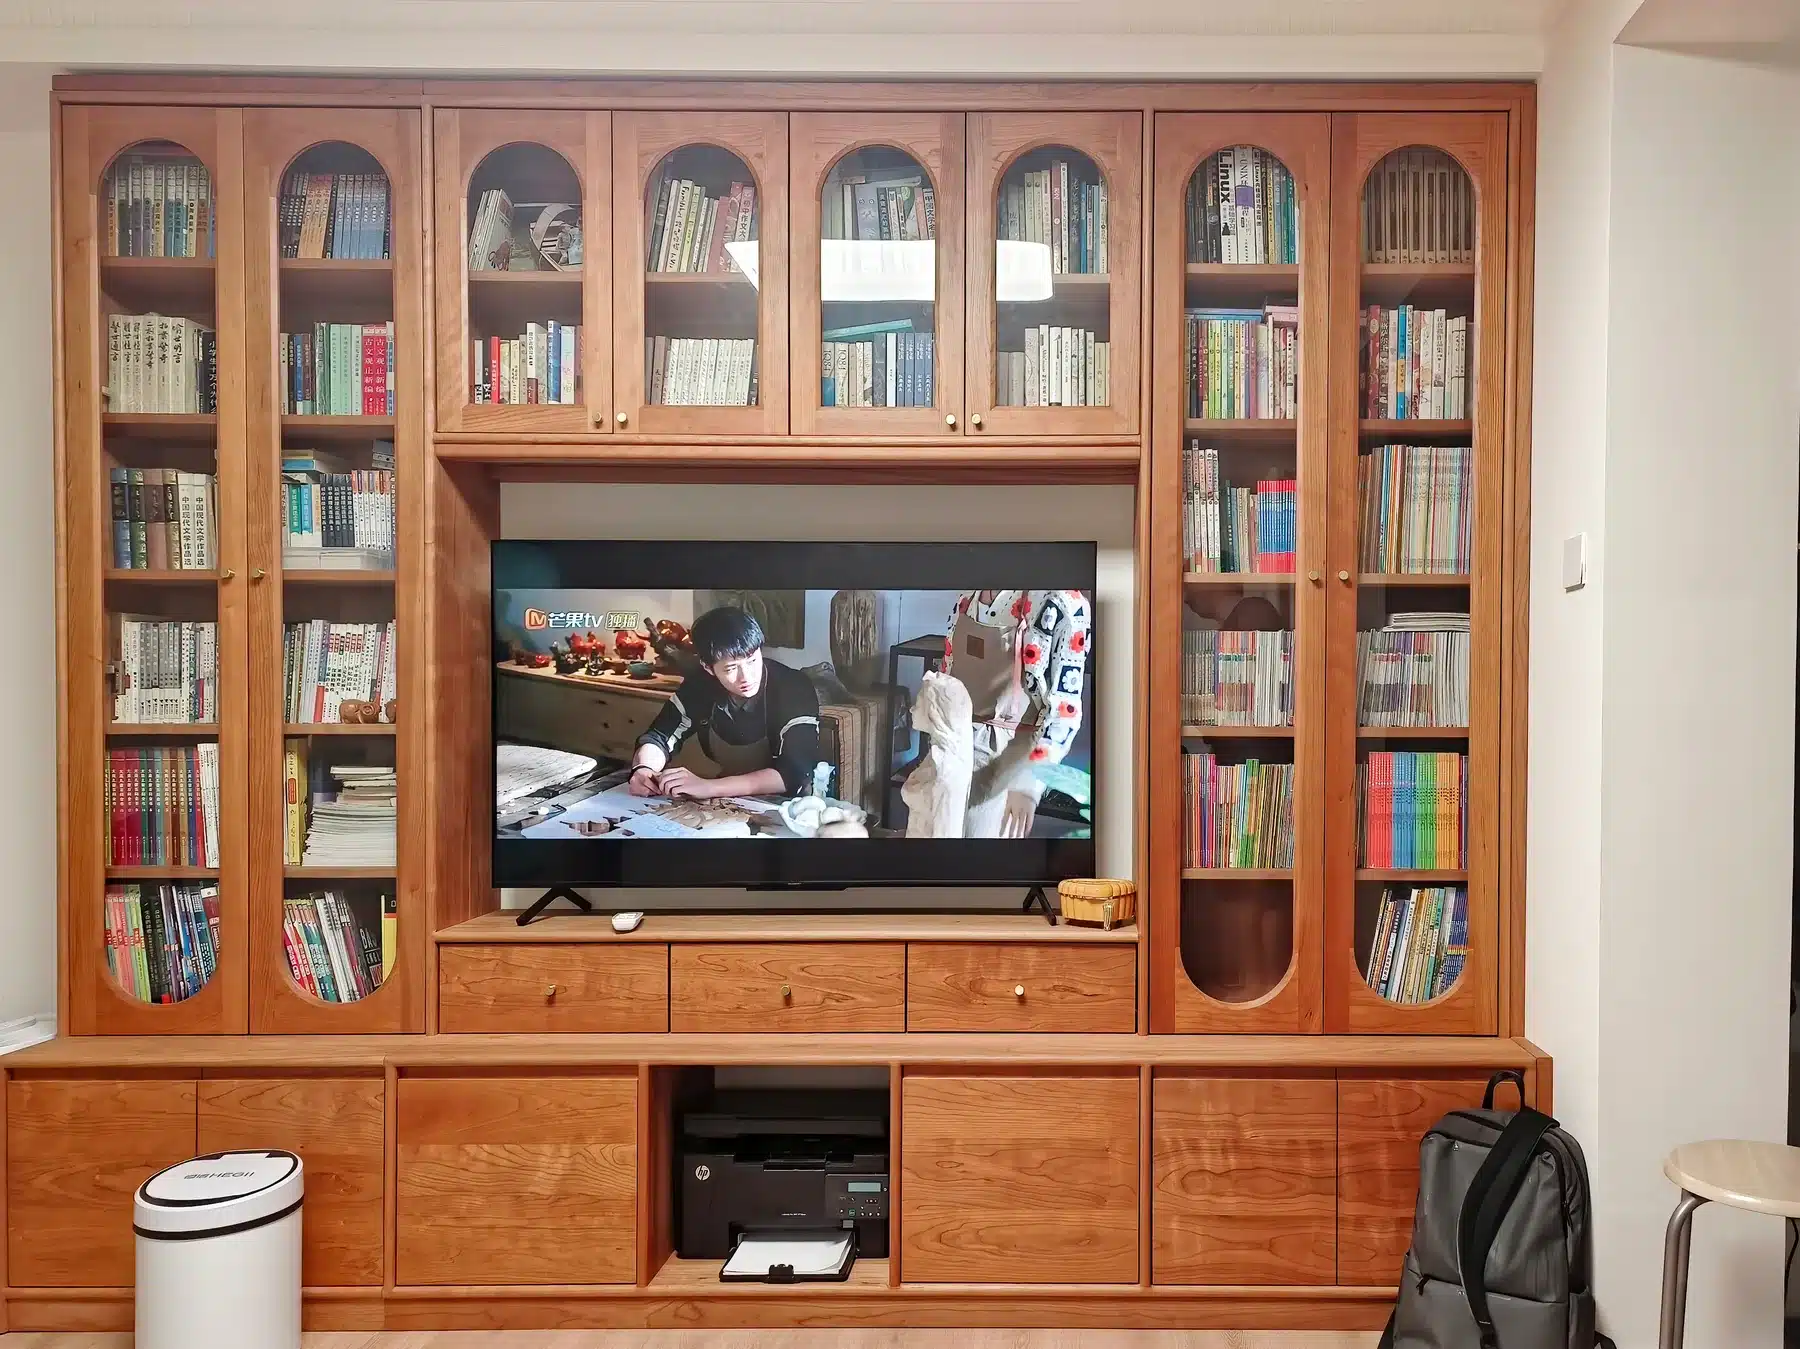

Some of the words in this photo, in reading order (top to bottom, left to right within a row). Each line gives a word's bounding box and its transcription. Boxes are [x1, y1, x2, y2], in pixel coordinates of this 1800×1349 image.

[1220, 152, 1233, 203] Linux
[364, 338, 374, 393] 古文观止新编
[375, 338, 385, 393] 古文观止新编
[182, 496, 191, 566] 中国现代文学作品选
[196, 496, 205, 566] 中国现代文学作品选
[548, 612, 604, 628] 芒果tv
[608, 613, 636, 628] 独播
[209, 1171, 255, 1179] HEGII
[696, 1165, 710, 1180] hp
